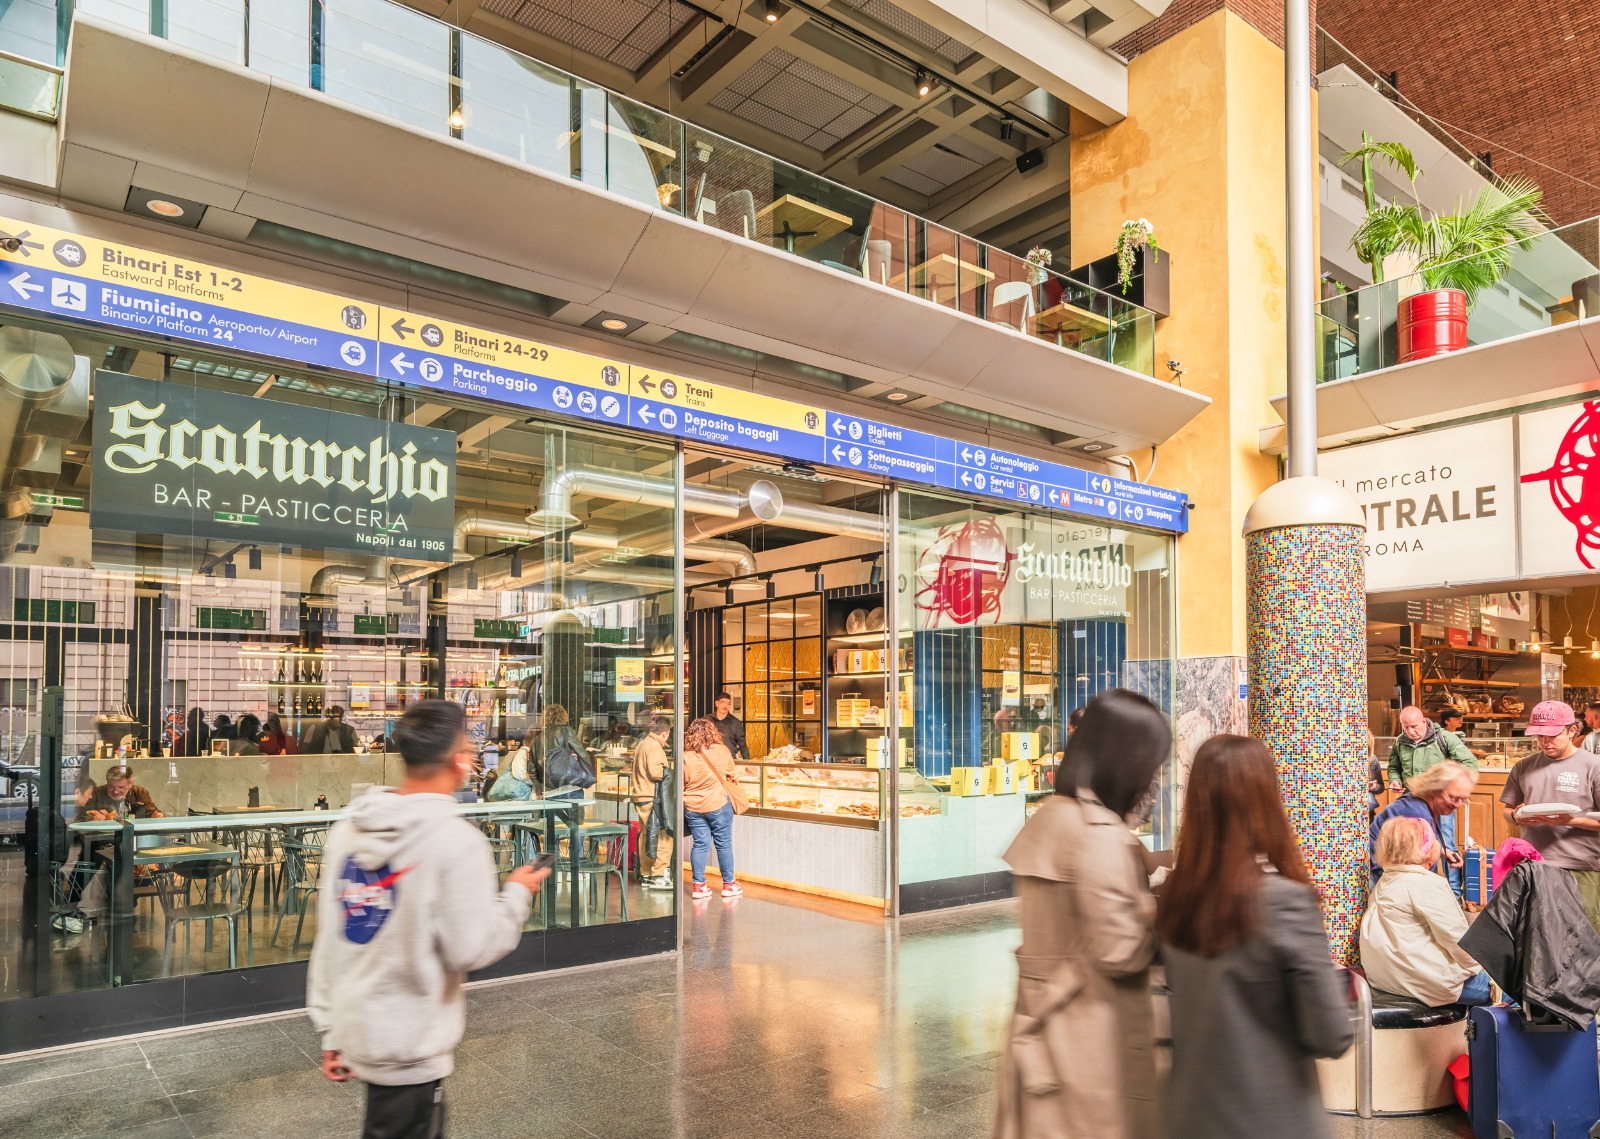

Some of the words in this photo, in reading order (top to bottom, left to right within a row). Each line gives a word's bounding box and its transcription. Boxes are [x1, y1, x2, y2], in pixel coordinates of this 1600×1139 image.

[102, 247, 167, 276] Binari
[173, 263, 203, 283] Est
[210, 272, 243, 293] 1-2
[102, 264, 163, 288] Eastward
[168, 278, 225, 301] Platforms
[101, 287, 203, 322] Fiumicino
[213, 328, 234, 342] 24
[454, 330, 499, 351] Binari
[503, 341, 549, 362] 24-29
[454, 344, 496, 362] Platforms
[453, 363, 538, 392] Parcheggio
[453, 378, 487, 395] Parking
[685, 383, 713, 399] Treni
[685, 395, 706, 407] Trains
[685, 412, 735, 432] Deposito
[737, 422, 779, 443] bagagli
[685, 425, 698, 435] Left
[699, 428, 729, 441] Luggage
[868, 424, 902, 441] Biglietti
[104, 400, 449, 504] Scaturchio
[868, 450, 934, 474] Sottopassaggio
[868, 461, 889, 473] Subway
[990, 453, 1039, 472] Autonoleggio
[990, 475, 1015, 489] Servizi
[1356, 464, 1453, 493] mercato
[154, 483, 211, 509] BAR
[1074, 492, 1093, 505] Metro
[1114, 481, 1151, 497] Informazioni
[1152, 491, 1177, 502] turistiche
[1146, 508, 1173, 522] Shopping
[356, 533, 393, 547] Napoli
[399, 536, 416, 548] dal
[421, 539, 445, 551] 1905
[1015, 542, 1132, 591] Scaturchio
[1030, 587, 1050, 600] BAR
[1059, 591, 1118, 606] PASTICCERIA
